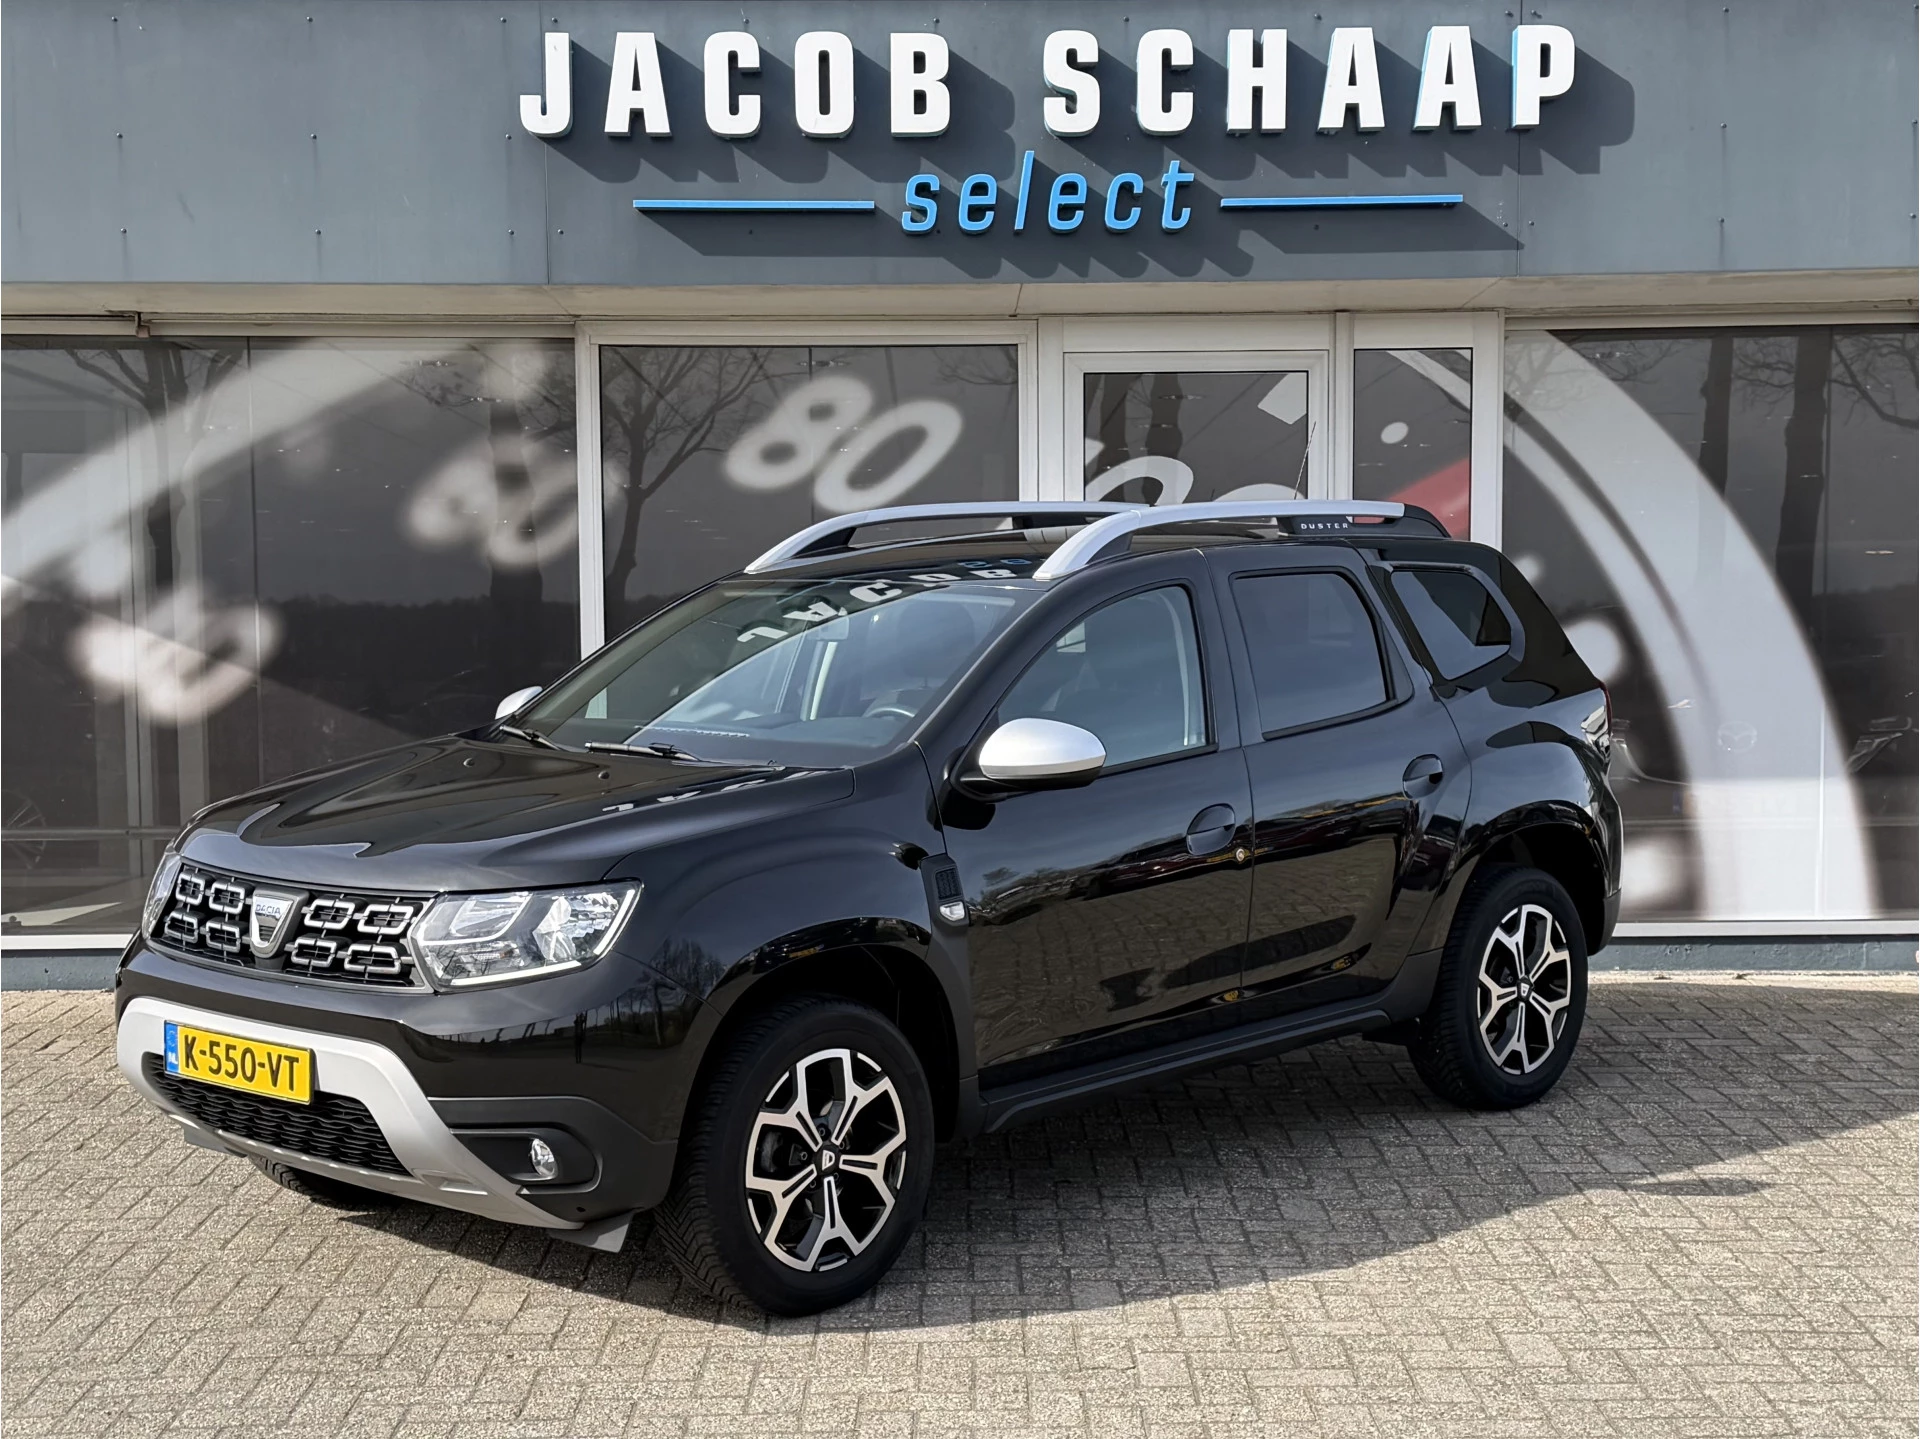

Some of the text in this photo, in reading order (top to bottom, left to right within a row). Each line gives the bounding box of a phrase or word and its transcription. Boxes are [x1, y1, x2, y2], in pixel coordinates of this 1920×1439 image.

[519, 24, 1577, 139] JACOB SCHAAP
[901, 150, 1195, 235] select
[725, 375, 963, 512] 80
[1300, 522, 1348, 530] DUSTER
[255, 903, 281, 915] DACIA
[184, 1034, 299, 1091] K-550-VT
